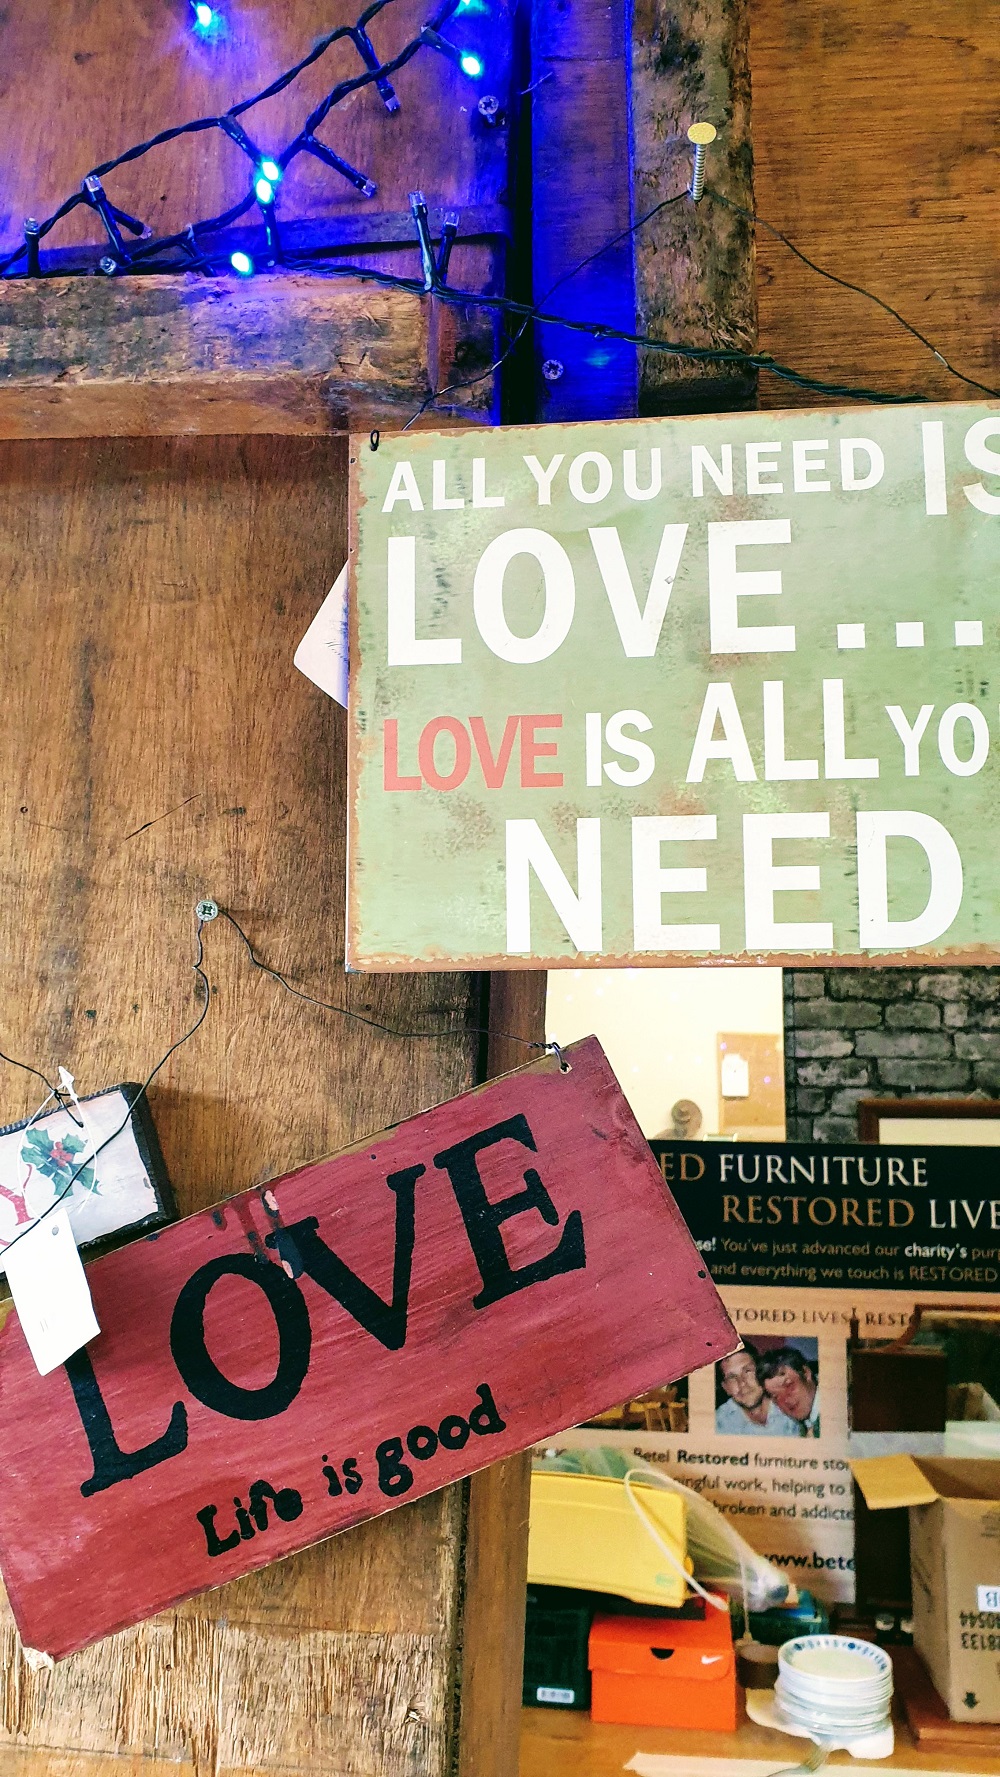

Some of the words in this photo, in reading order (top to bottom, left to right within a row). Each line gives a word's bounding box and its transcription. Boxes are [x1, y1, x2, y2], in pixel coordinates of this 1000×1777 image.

[382, 457, 505, 513] ALL
[523, 448, 662, 505] YOU
[691, 438, 885, 497] NEED
[922, 416, 1000, 515] IS
[383, 714, 564, 791] LOVE
[585, 709, 656, 788] IS
[686, 678, 879, 783] ALL
[885, 702, 1000, 777] YO
[505, 810, 964, 954] NEED
[719, 1153, 929, 1187] FURNITURE
[722, 1195, 916, 1228] RESTORED
[929, 1199, 1000, 1230] LIVE
[721, 1238, 769, 1253] You've
[772, 1240, 798, 1257] just
[802, 1240, 870, 1256] advanced
[874, 1244, 900, 1257] our
[904, 1242, 969, 1262] charity's
[710, 1262, 737, 1275] and
[741, 1263, 817, 1282] everything
[820, 1267, 843, 1279] we
[847, 1265, 890, 1280] touch
[893, 1266, 904, 1281] is
[909, 1265, 999, 1282] RESTORED
[65, 1114, 587, 1498] LOVE
[729, 1306, 796, 1324] TORED
[321, 1454, 363, 1497] is
[376, 1383, 507, 1497] good
[677, 1449, 749, 1467] Restored
[754, 1451, 819, 1471] furniture
[724, 1476, 767, 1493] work,
[772, 1479, 825, 1498] helping
[829, 1483, 846, 1497] to
[770, 1502, 796, 1518] and
